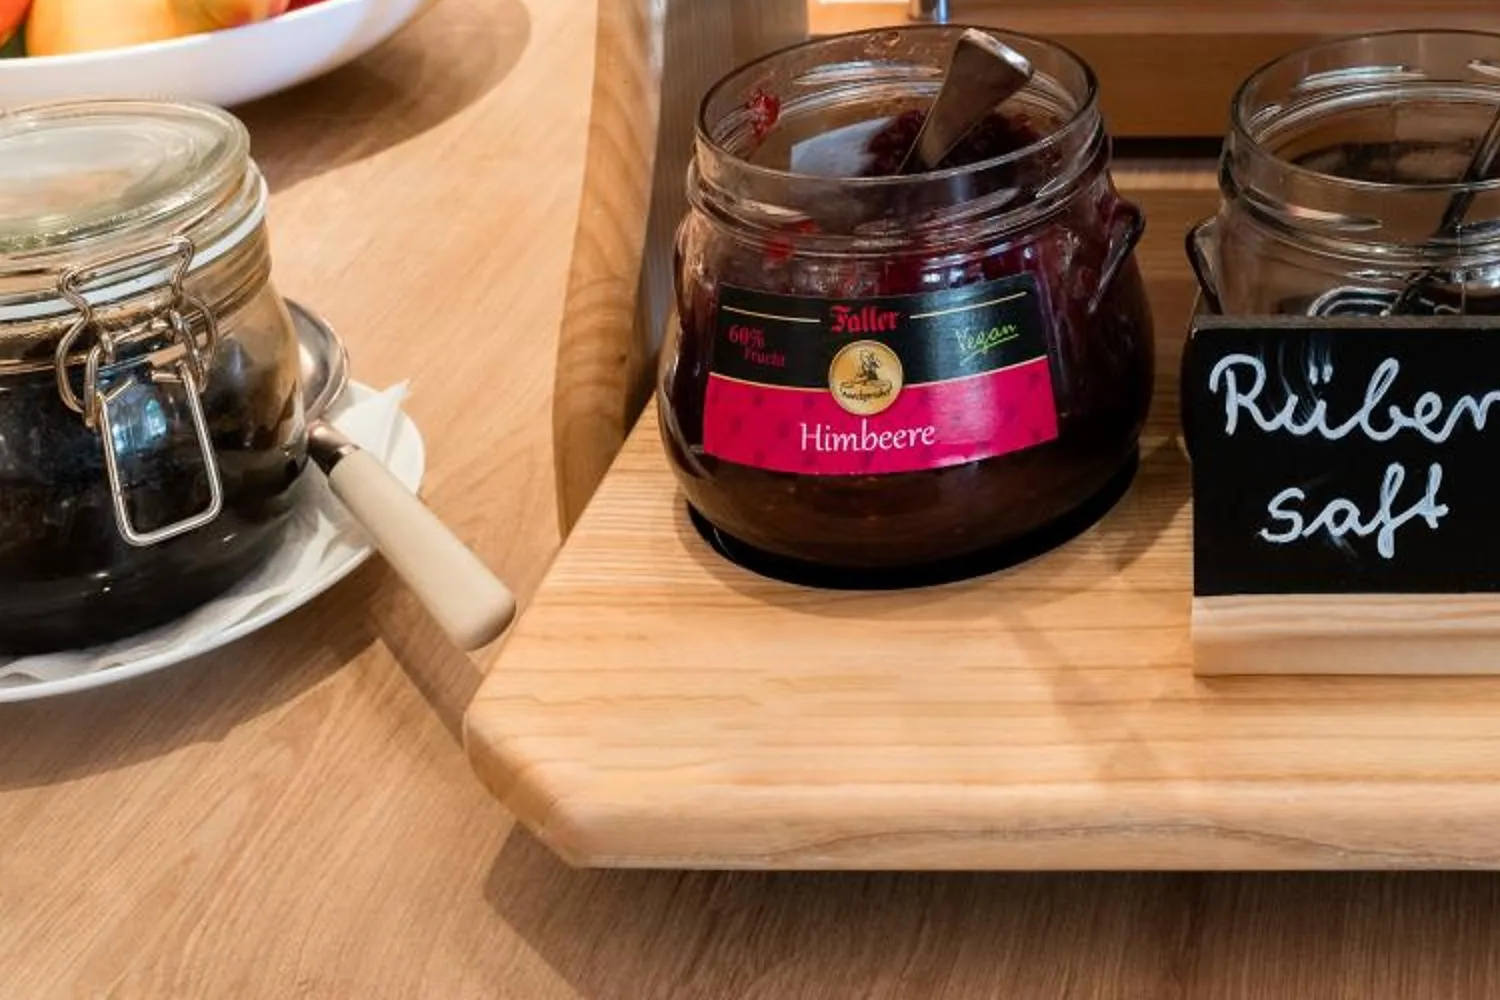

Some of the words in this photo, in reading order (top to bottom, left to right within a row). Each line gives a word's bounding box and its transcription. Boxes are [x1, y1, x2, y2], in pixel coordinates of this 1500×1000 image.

[831, 305, 899, 334] Faller
[727, 324, 766, 350] 60%
[955, 322, 1016, 354] Vegan
[800, 418, 936, 453] Himbeere
[1259, 462, 1449, 559] saft
